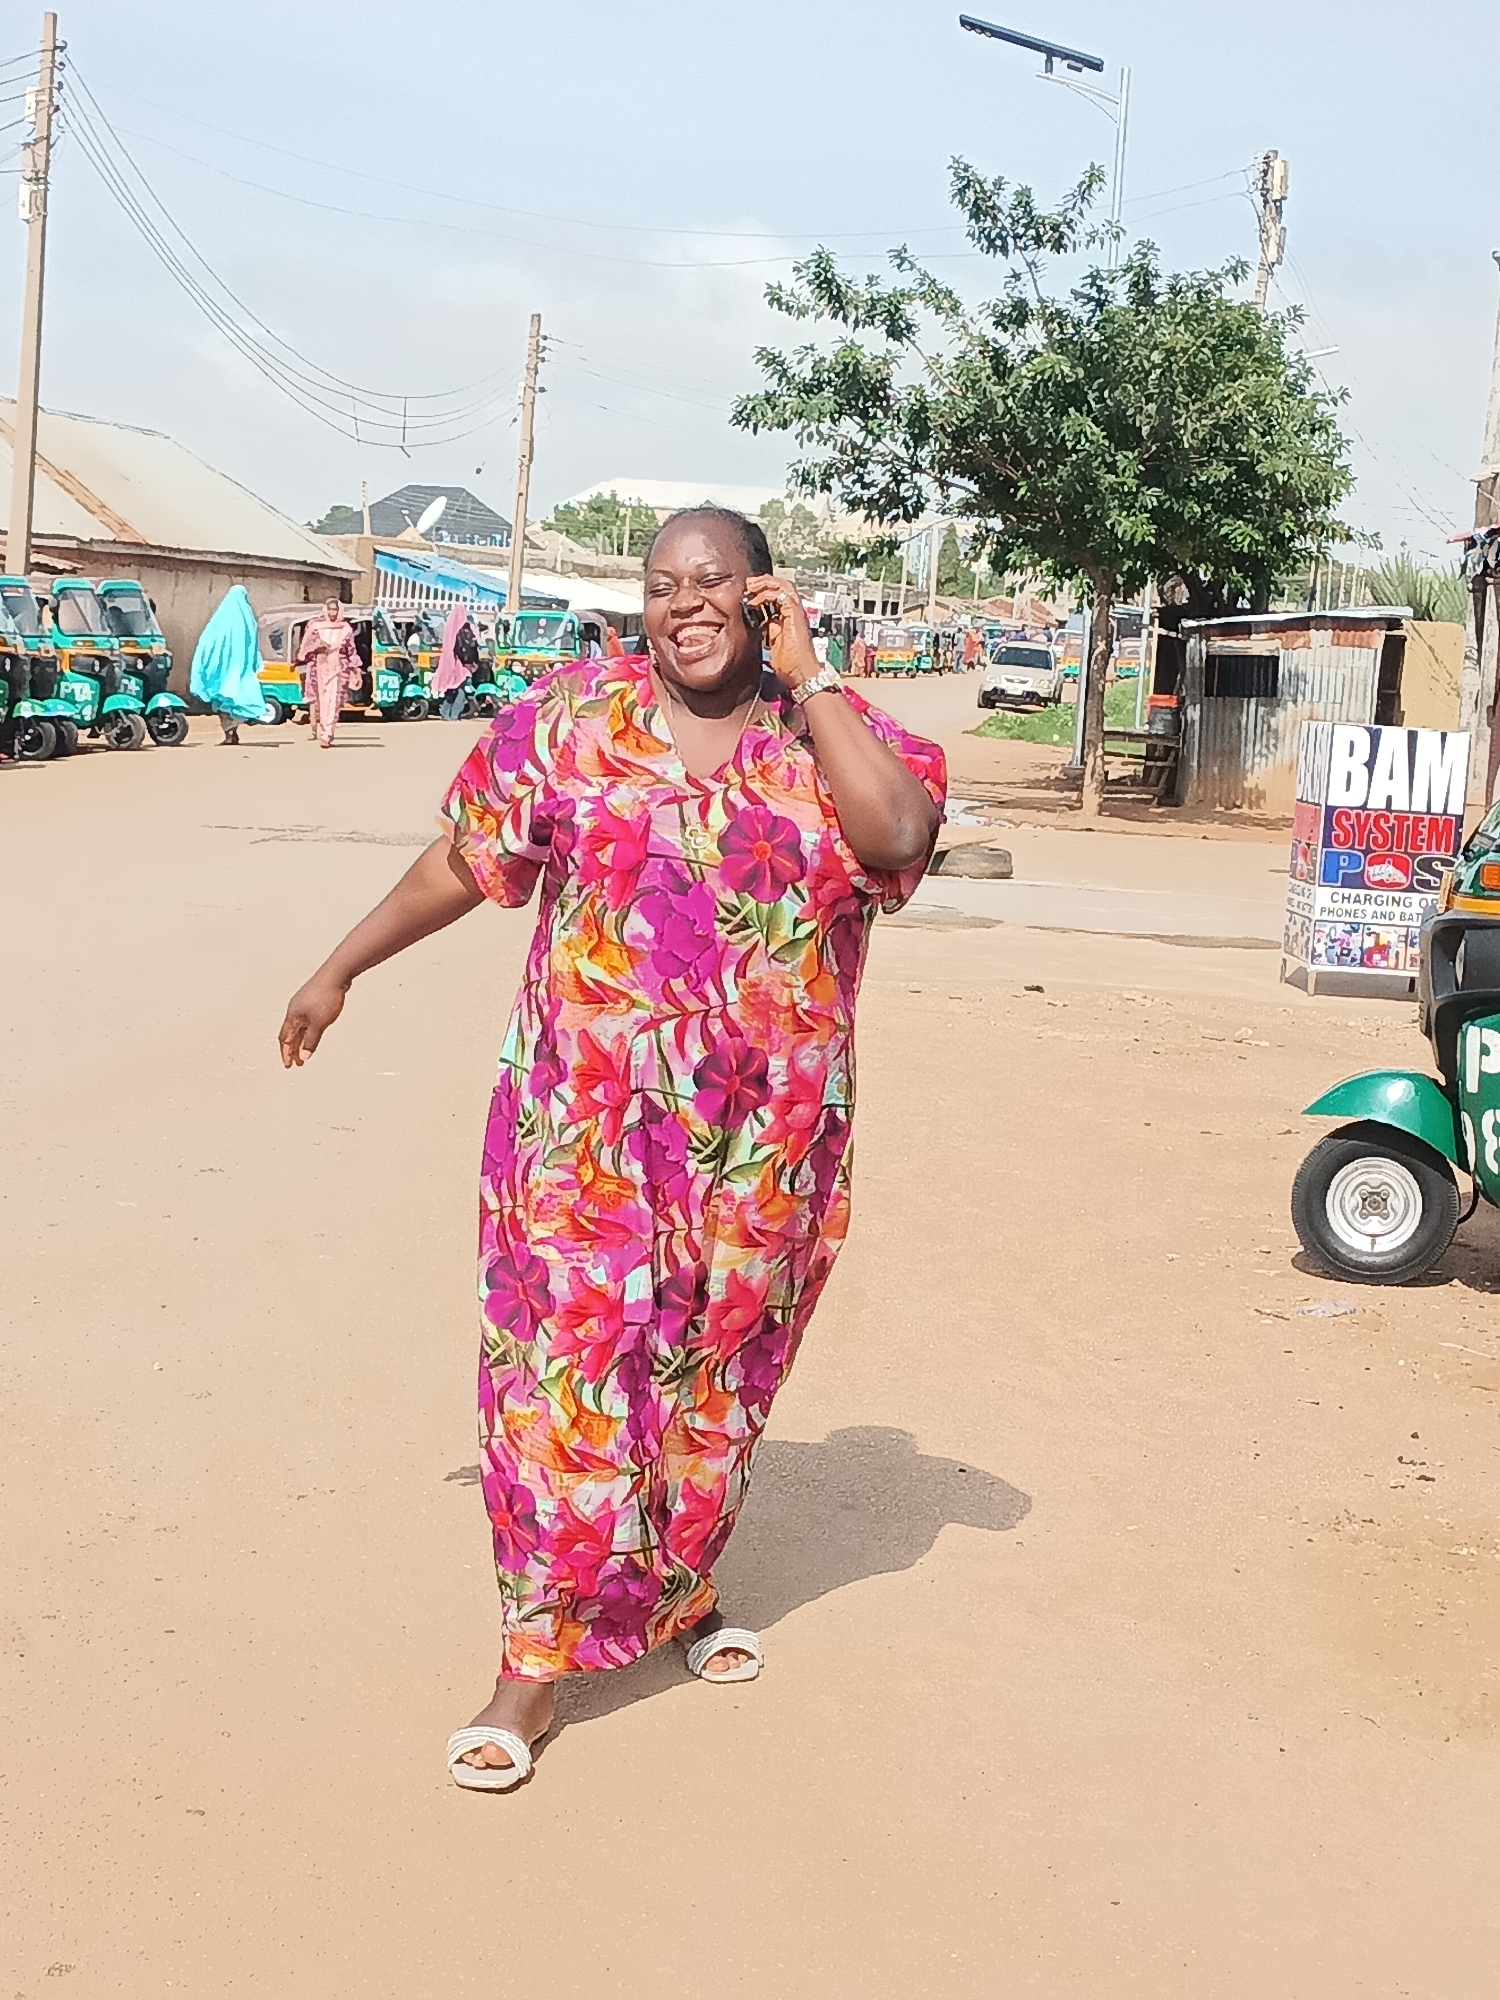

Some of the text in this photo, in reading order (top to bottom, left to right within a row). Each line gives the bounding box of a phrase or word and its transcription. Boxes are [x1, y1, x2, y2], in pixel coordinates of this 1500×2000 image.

[1327, 723, 1470, 815] BAM
[1332, 808, 1454, 854] SYSTEM
[1319, 906, 1367, 920] PHONES
[1371, 909, 1396, 921] AND
[1330, 891, 1413, 909] CHARGING
